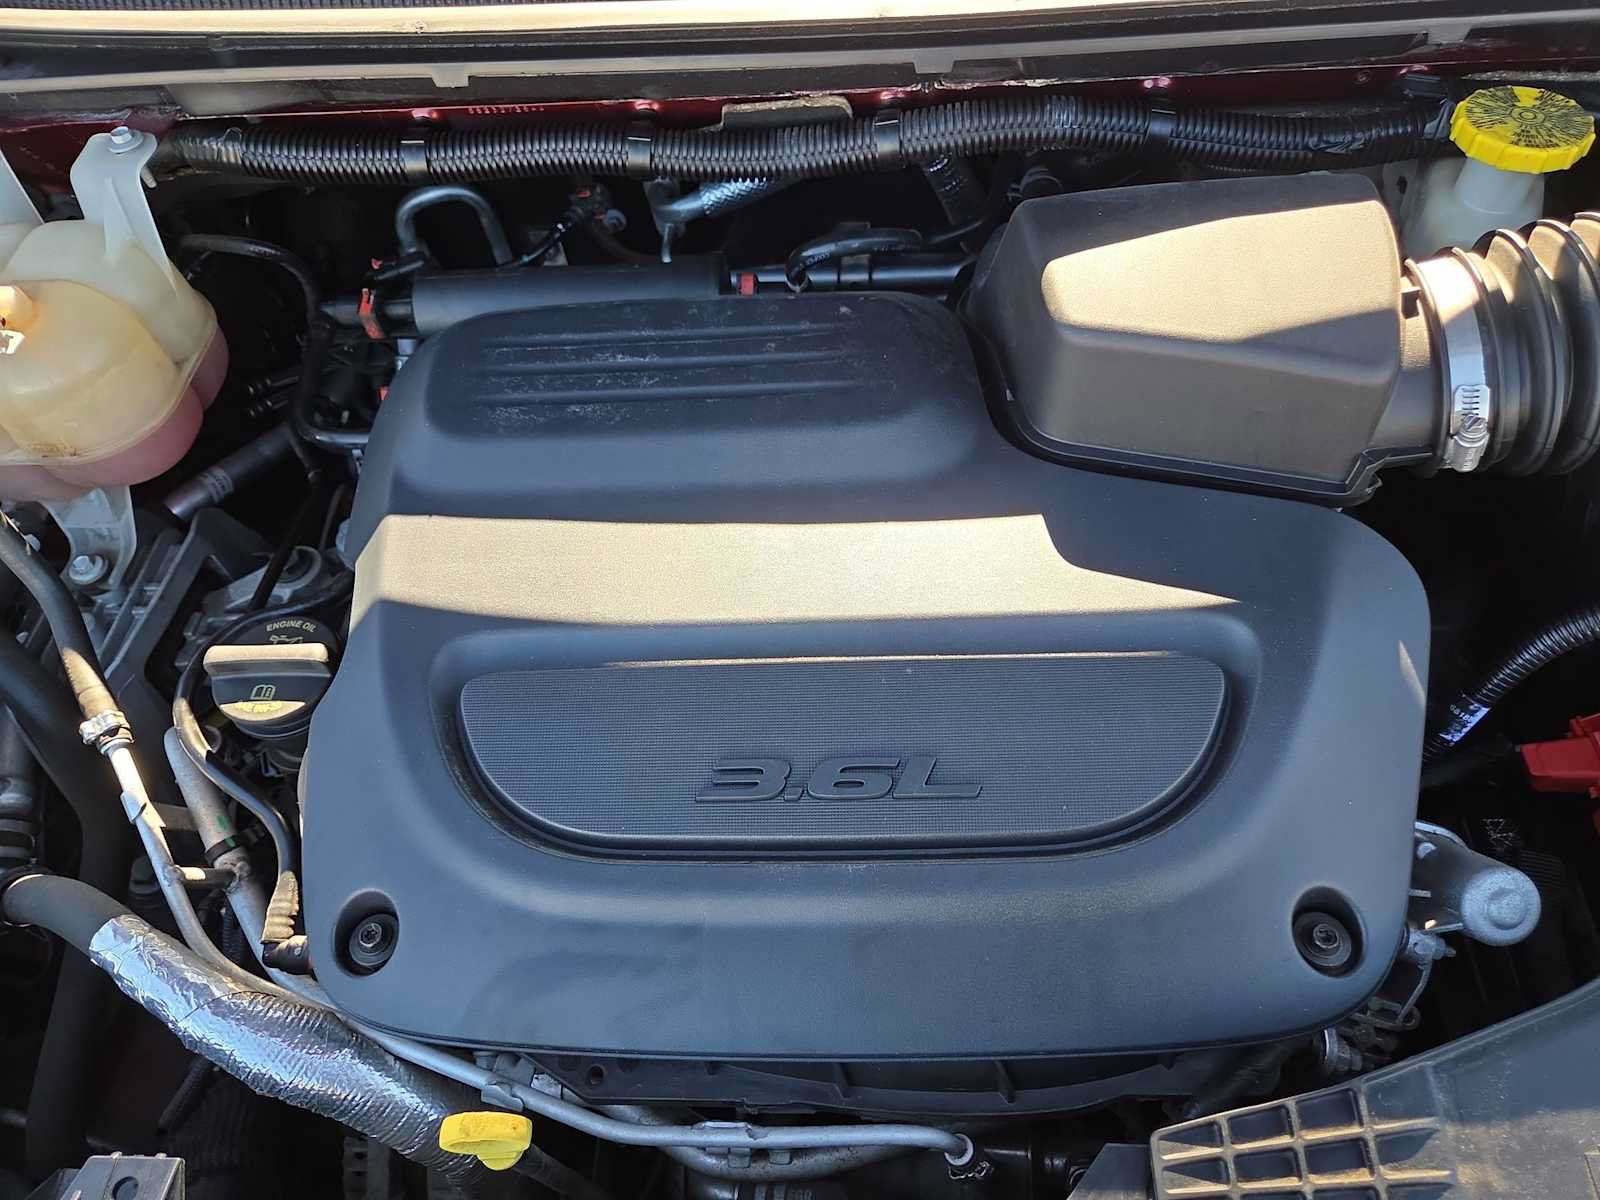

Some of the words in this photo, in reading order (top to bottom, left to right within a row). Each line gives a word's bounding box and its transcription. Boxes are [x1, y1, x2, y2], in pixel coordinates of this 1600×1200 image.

[266, 620, 304, 632] ENGINE
[302, 621, 317, 633] OIL
[695, 756, 982, 802] 3.6L
